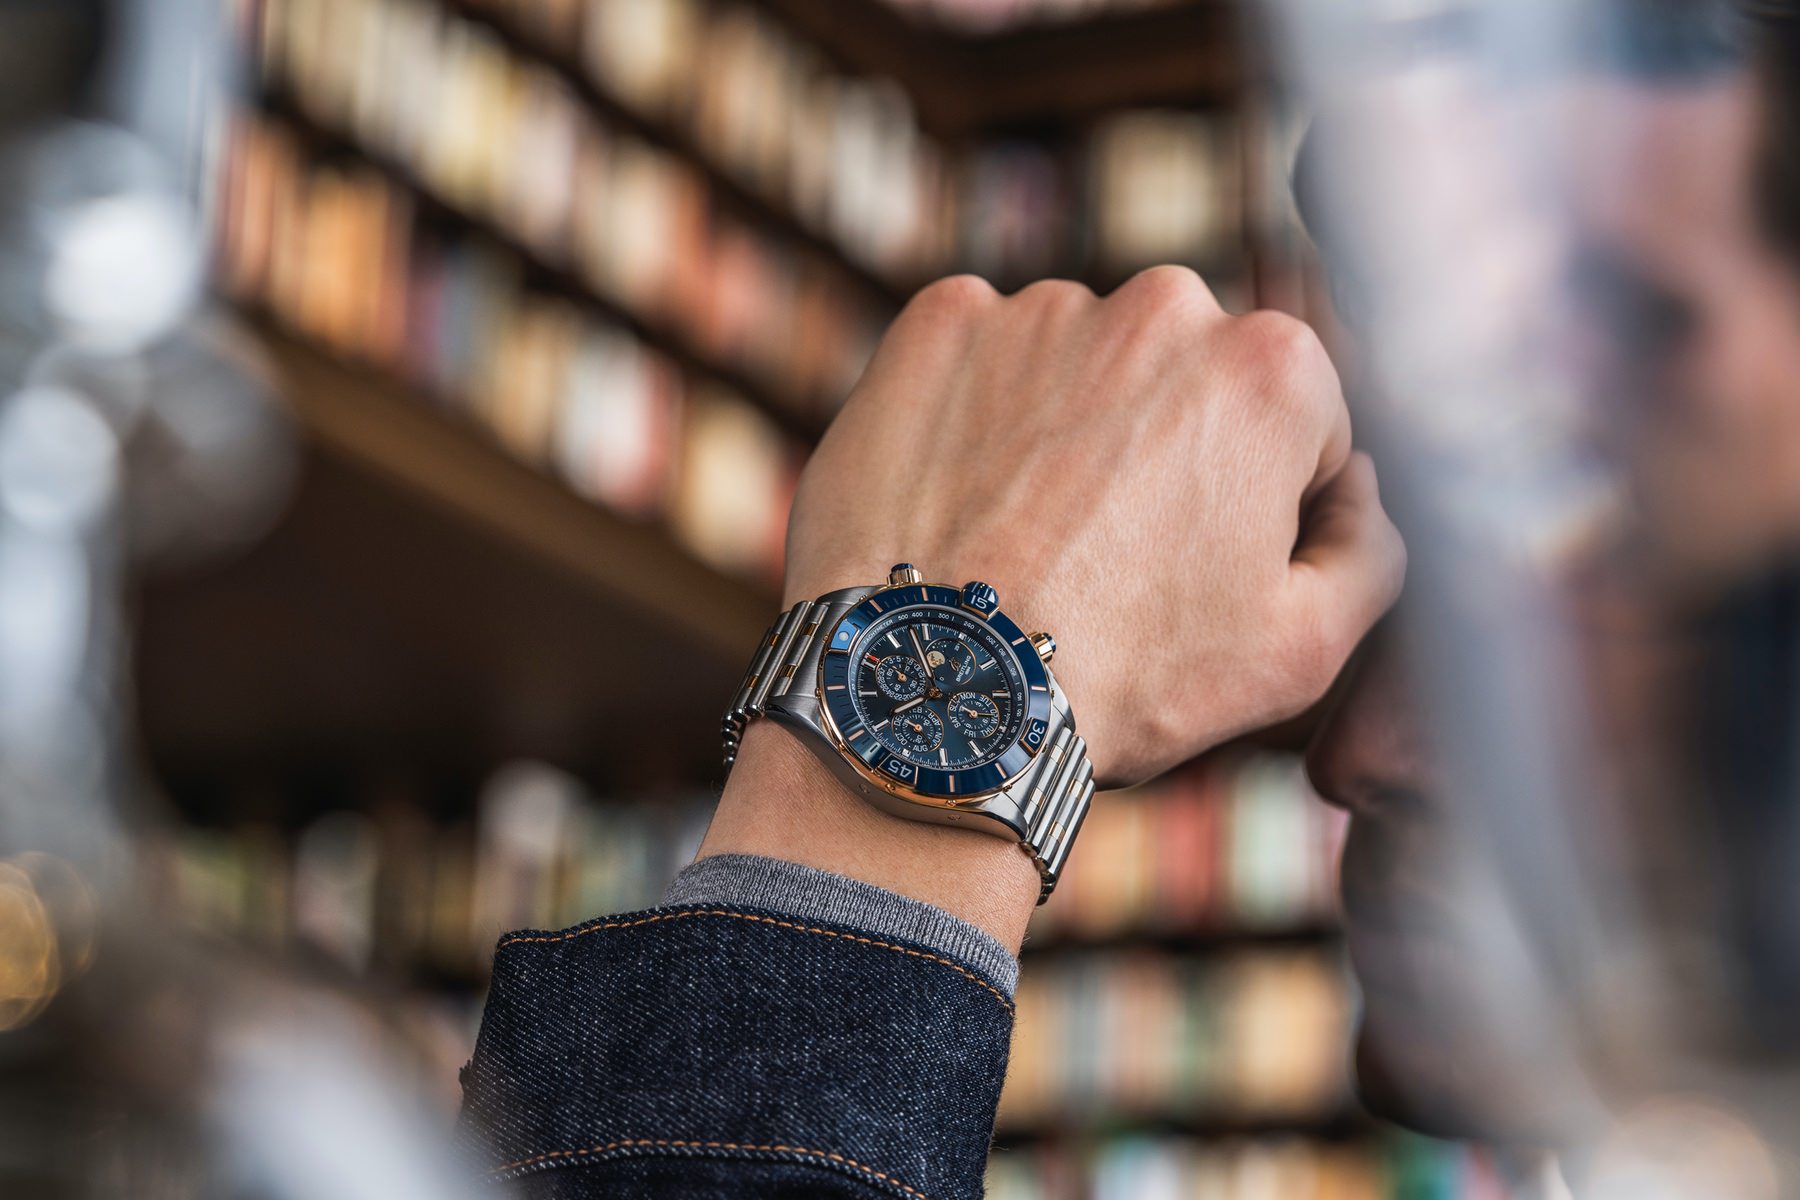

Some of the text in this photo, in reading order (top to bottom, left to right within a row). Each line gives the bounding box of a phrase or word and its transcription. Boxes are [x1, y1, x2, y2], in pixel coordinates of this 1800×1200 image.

[970, 594, 987, 609] 15
[898, 613, 909, 621] 500
[938, 612, 950, 620] 300
[963, 620, 975, 630] 240
[886, 668, 894, 676] 60
[956, 655, 971, 682] BREITLING
[910, 680, 918, 688] 30
[960, 692, 976, 700] MON
[979, 694, 992, 707] TUE
[909, 706, 923, 714] EB
[893, 714, 905, 727] DEC
[927, 712, 940, 726] APR
[949, 715, 961, 729] SAT
[963, 729, 977, 738] FRI
[980, 725, 995, 737] THU
[1028, 721, 1045, 744] 30
[894, 732, 908, 746] OCT
[932, 731, 942, 747] JUN
[912, 744, 928, 752] AUG
[888, 760, 912, 778] 45
